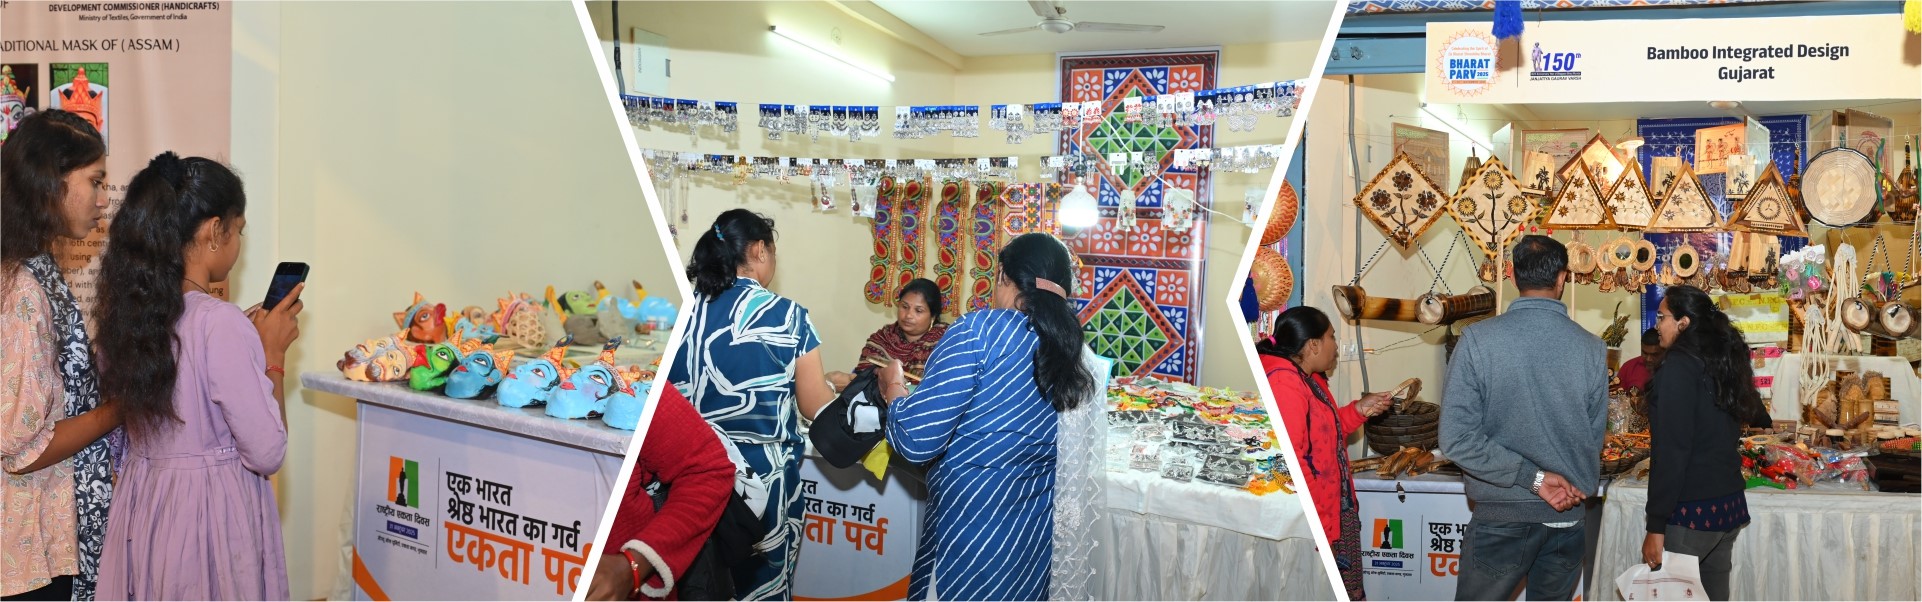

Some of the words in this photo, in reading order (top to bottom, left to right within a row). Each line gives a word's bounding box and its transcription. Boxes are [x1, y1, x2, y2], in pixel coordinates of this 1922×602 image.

[49, 3, 101, 12] DEVELOPMENT
[103, 3, 160, 11] COMMISSIONER
[161, 2, 220, 11] (HANDICRAFTS)
[79, 14, 101, 22] Ministry
[130, 13, 165, 21] Government
[62, 39, 98, 51] MASK
[101, 39, 118, 51] OF
[128, 38, 173, 51] ASSAM
[1647, 46, 1708, 60] Bamboo
[1712, 44, 1793, 62] Integrated
[1797, 43, 1849, 60] Design
[1450, 58, 1490, 69] BHARAT
[1450, 69, 1476, 80] PARV
[1718, 66, 1775, 83] Gujarat
[71, 253, 91, 263] using
[446, 471, 472, 495] एक
[476, 478, 513, 507] भारत
[826, 500, 848, 518] का
[851, 503, 876, 523] गर्व
[447, 490, 475, 525] श्रेष्ठ
[479, 505, 519, 536] भारत
[523, 515, 548, 544] का
[551, 520, 581, 552] गर्व
[1429, 522, 1452, 536] एक
[842, 517, 889, 556] पर्व
[1430, 533, 1455, 553] श्रेष्ठ
[444, 520, 534, 585] एकता
